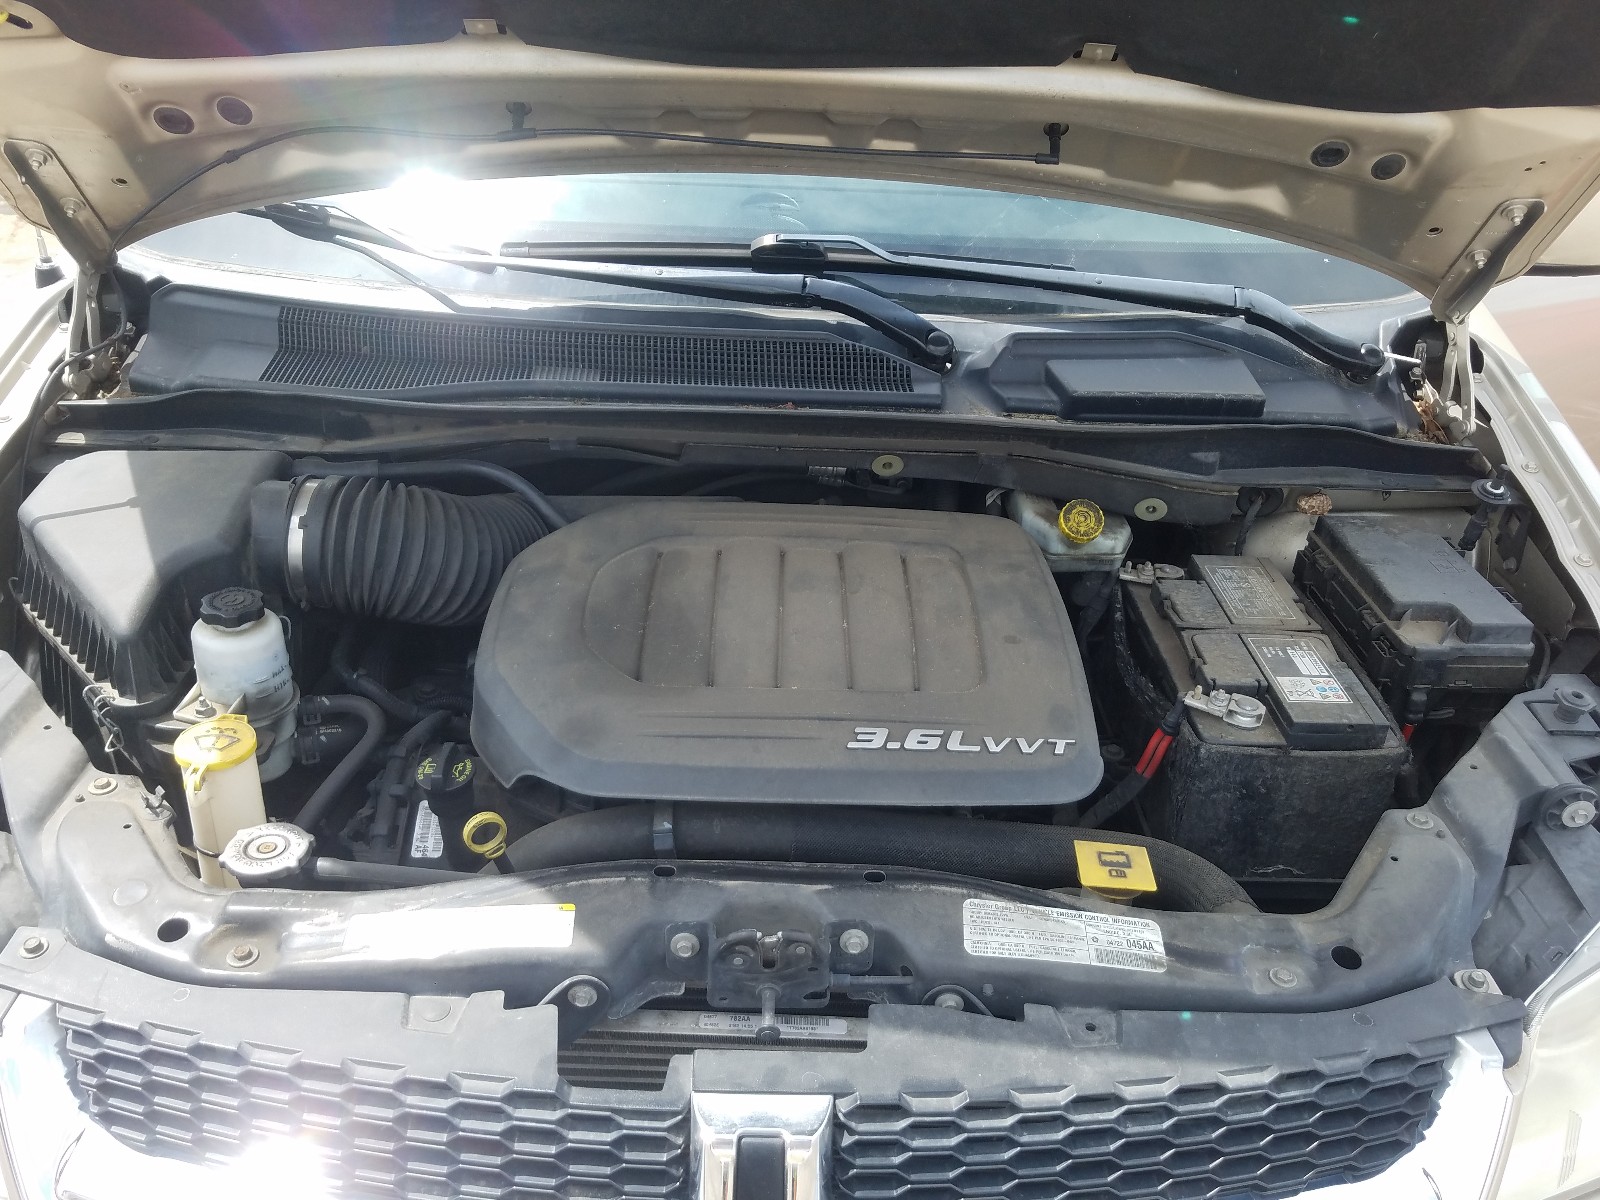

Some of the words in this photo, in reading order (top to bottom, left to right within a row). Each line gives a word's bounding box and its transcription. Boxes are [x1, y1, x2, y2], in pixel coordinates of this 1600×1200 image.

[969, 901, 993, 910] Chrysler
[995, 903, 1012, 912] Group
[1056, 910, 1083, 920] EMISSION
[1085, 913, 1110, 923] CONTROL
[1111, 917, 1151, 928] INFORMATION
[1126, 939, 1155, 951] 045AA
